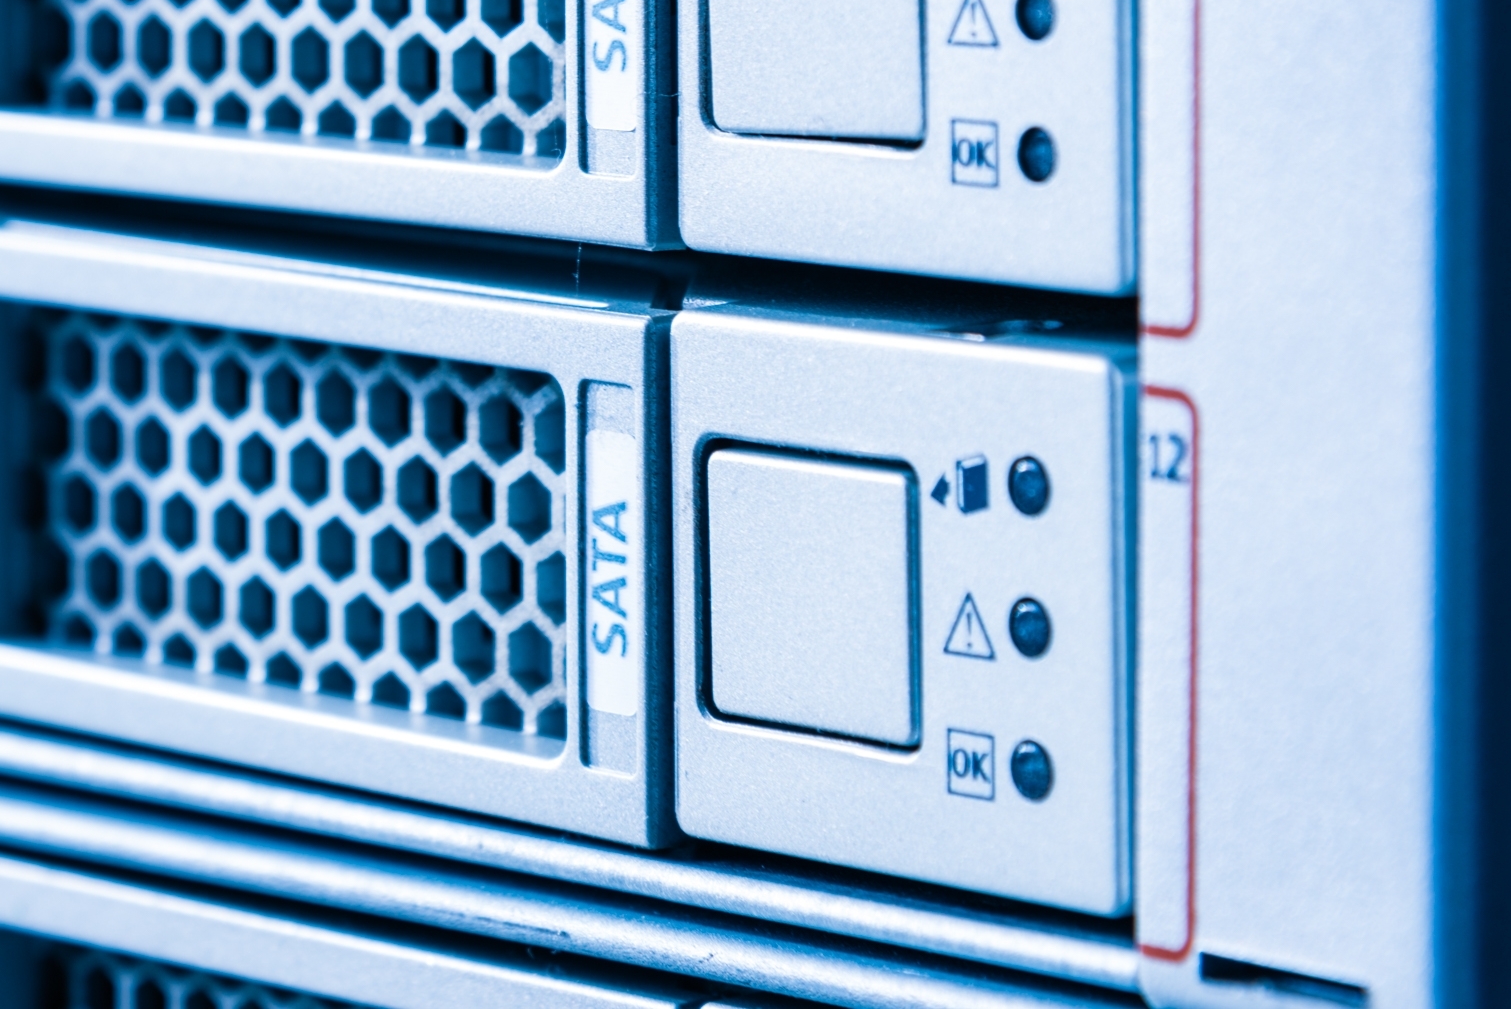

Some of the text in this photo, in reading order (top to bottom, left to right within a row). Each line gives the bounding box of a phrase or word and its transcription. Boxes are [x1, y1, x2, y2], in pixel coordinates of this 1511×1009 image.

[953, 138, 995, 168] OK
[1148, 433, 1188, 481] 12
[592, 498, 629, 657] SATA
[951, 748, 991, 782] OK
